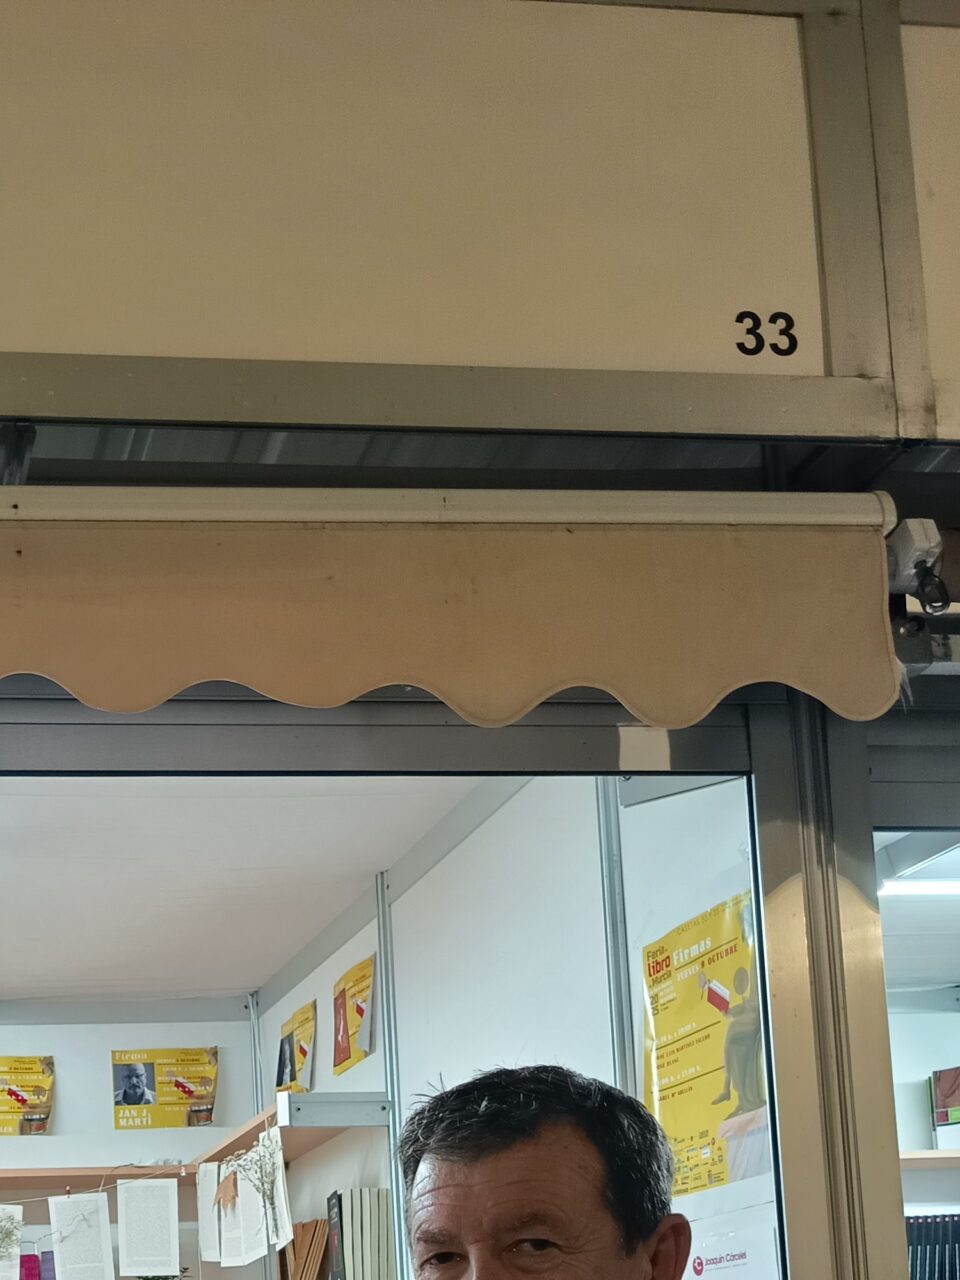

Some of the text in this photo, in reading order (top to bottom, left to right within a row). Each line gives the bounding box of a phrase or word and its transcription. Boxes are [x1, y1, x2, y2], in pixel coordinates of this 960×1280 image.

[735, 310, 798, 357] 33
[646, 946, 665, 961] Feria
[673, 937, 713, 965] Firmas
[707, 944, 738, 965] OCTUBRE
[647, 955, 671, 977] libro
[652, 970, 672, 986] Murcia
[119, 1109, 138, 1118] JAN
[119, 1117, 152, 1127] MARTÍ
